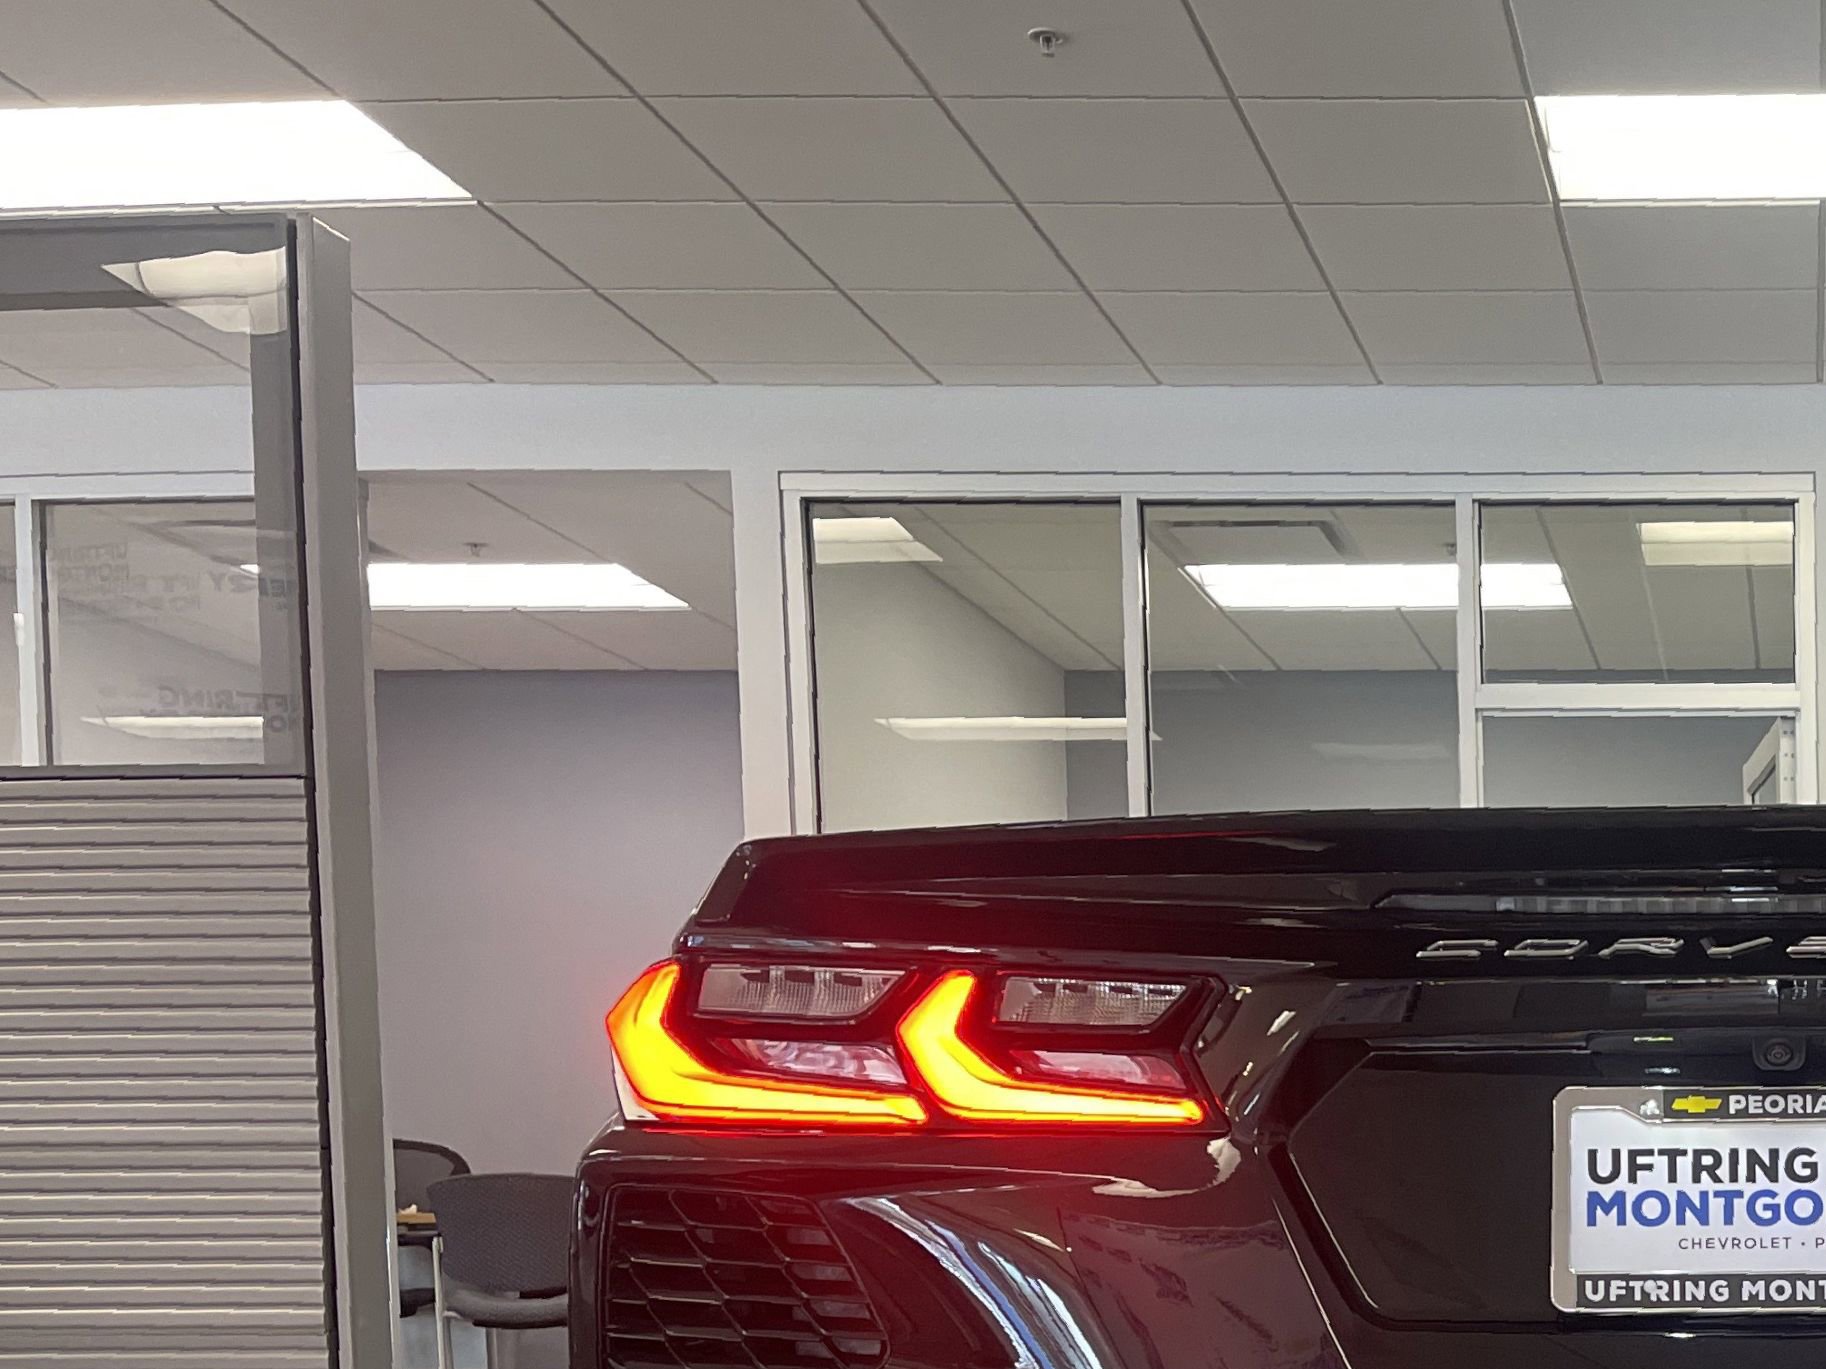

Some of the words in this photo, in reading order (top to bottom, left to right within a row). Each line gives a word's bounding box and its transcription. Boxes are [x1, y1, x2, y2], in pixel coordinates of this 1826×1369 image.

[1587, 1147, 1819, 1184] UFTRING
[1678, 1236, 1792, 1251] CHEVROLET
[1584, 1279, 1730, 1302] UFTRING
